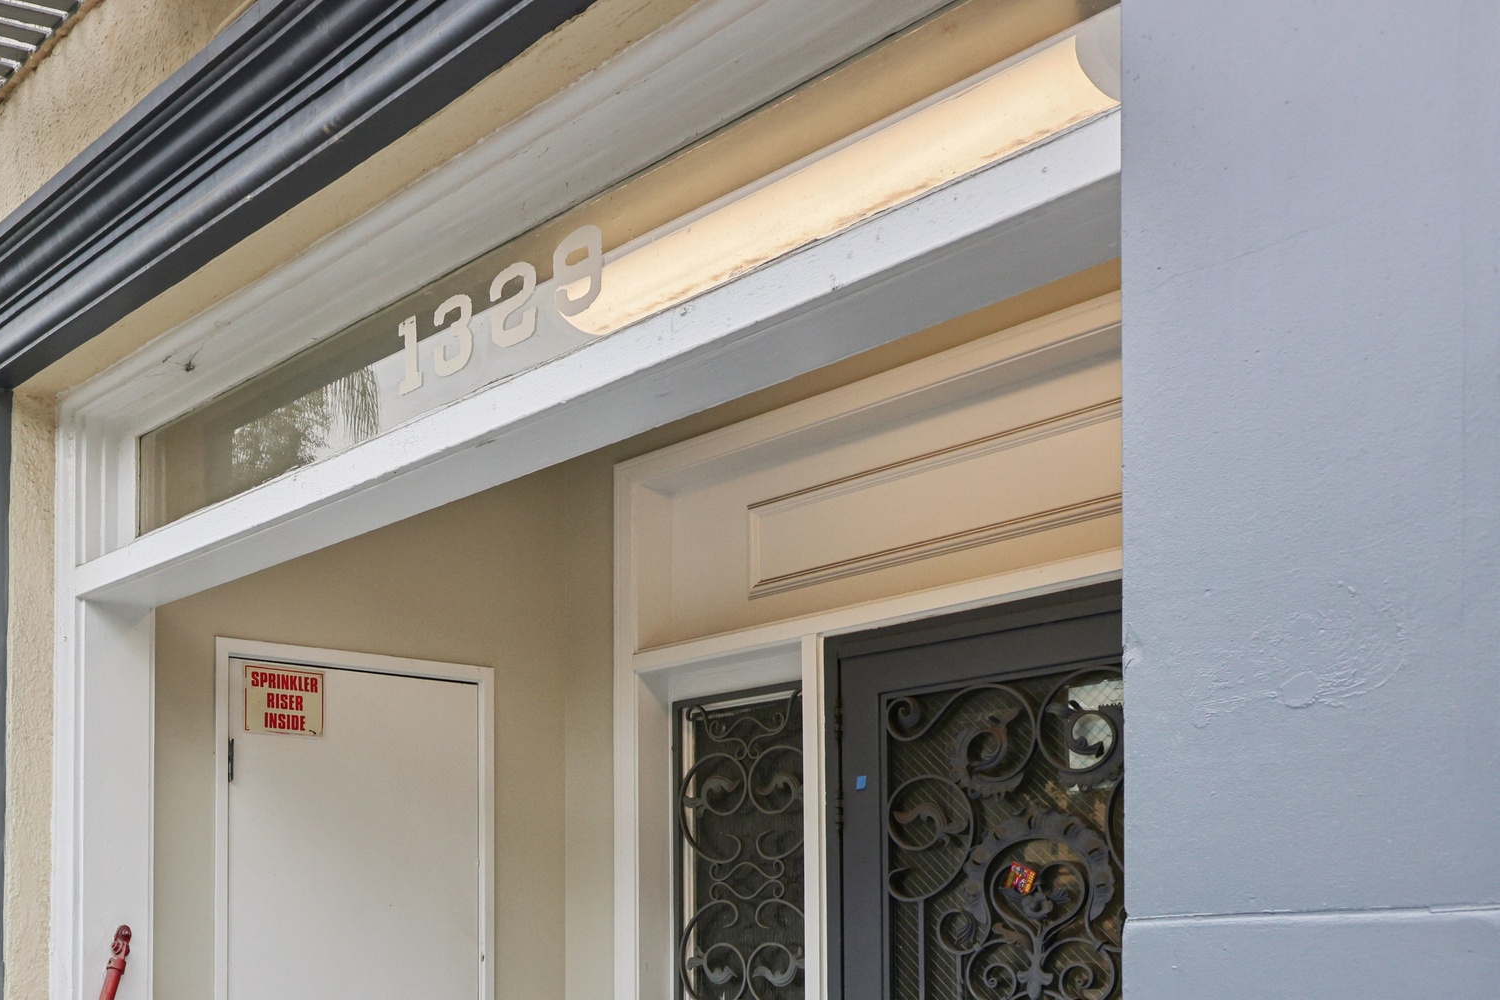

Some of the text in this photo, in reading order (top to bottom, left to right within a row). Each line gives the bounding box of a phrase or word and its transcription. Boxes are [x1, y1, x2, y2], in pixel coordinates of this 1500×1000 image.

[398, 224, 603, 396] 1329
[251, 671, 318, 693] SPRINKLER
[267, 692, 303, 711] RISER
[264, 712, 305, 731] INSIDE
